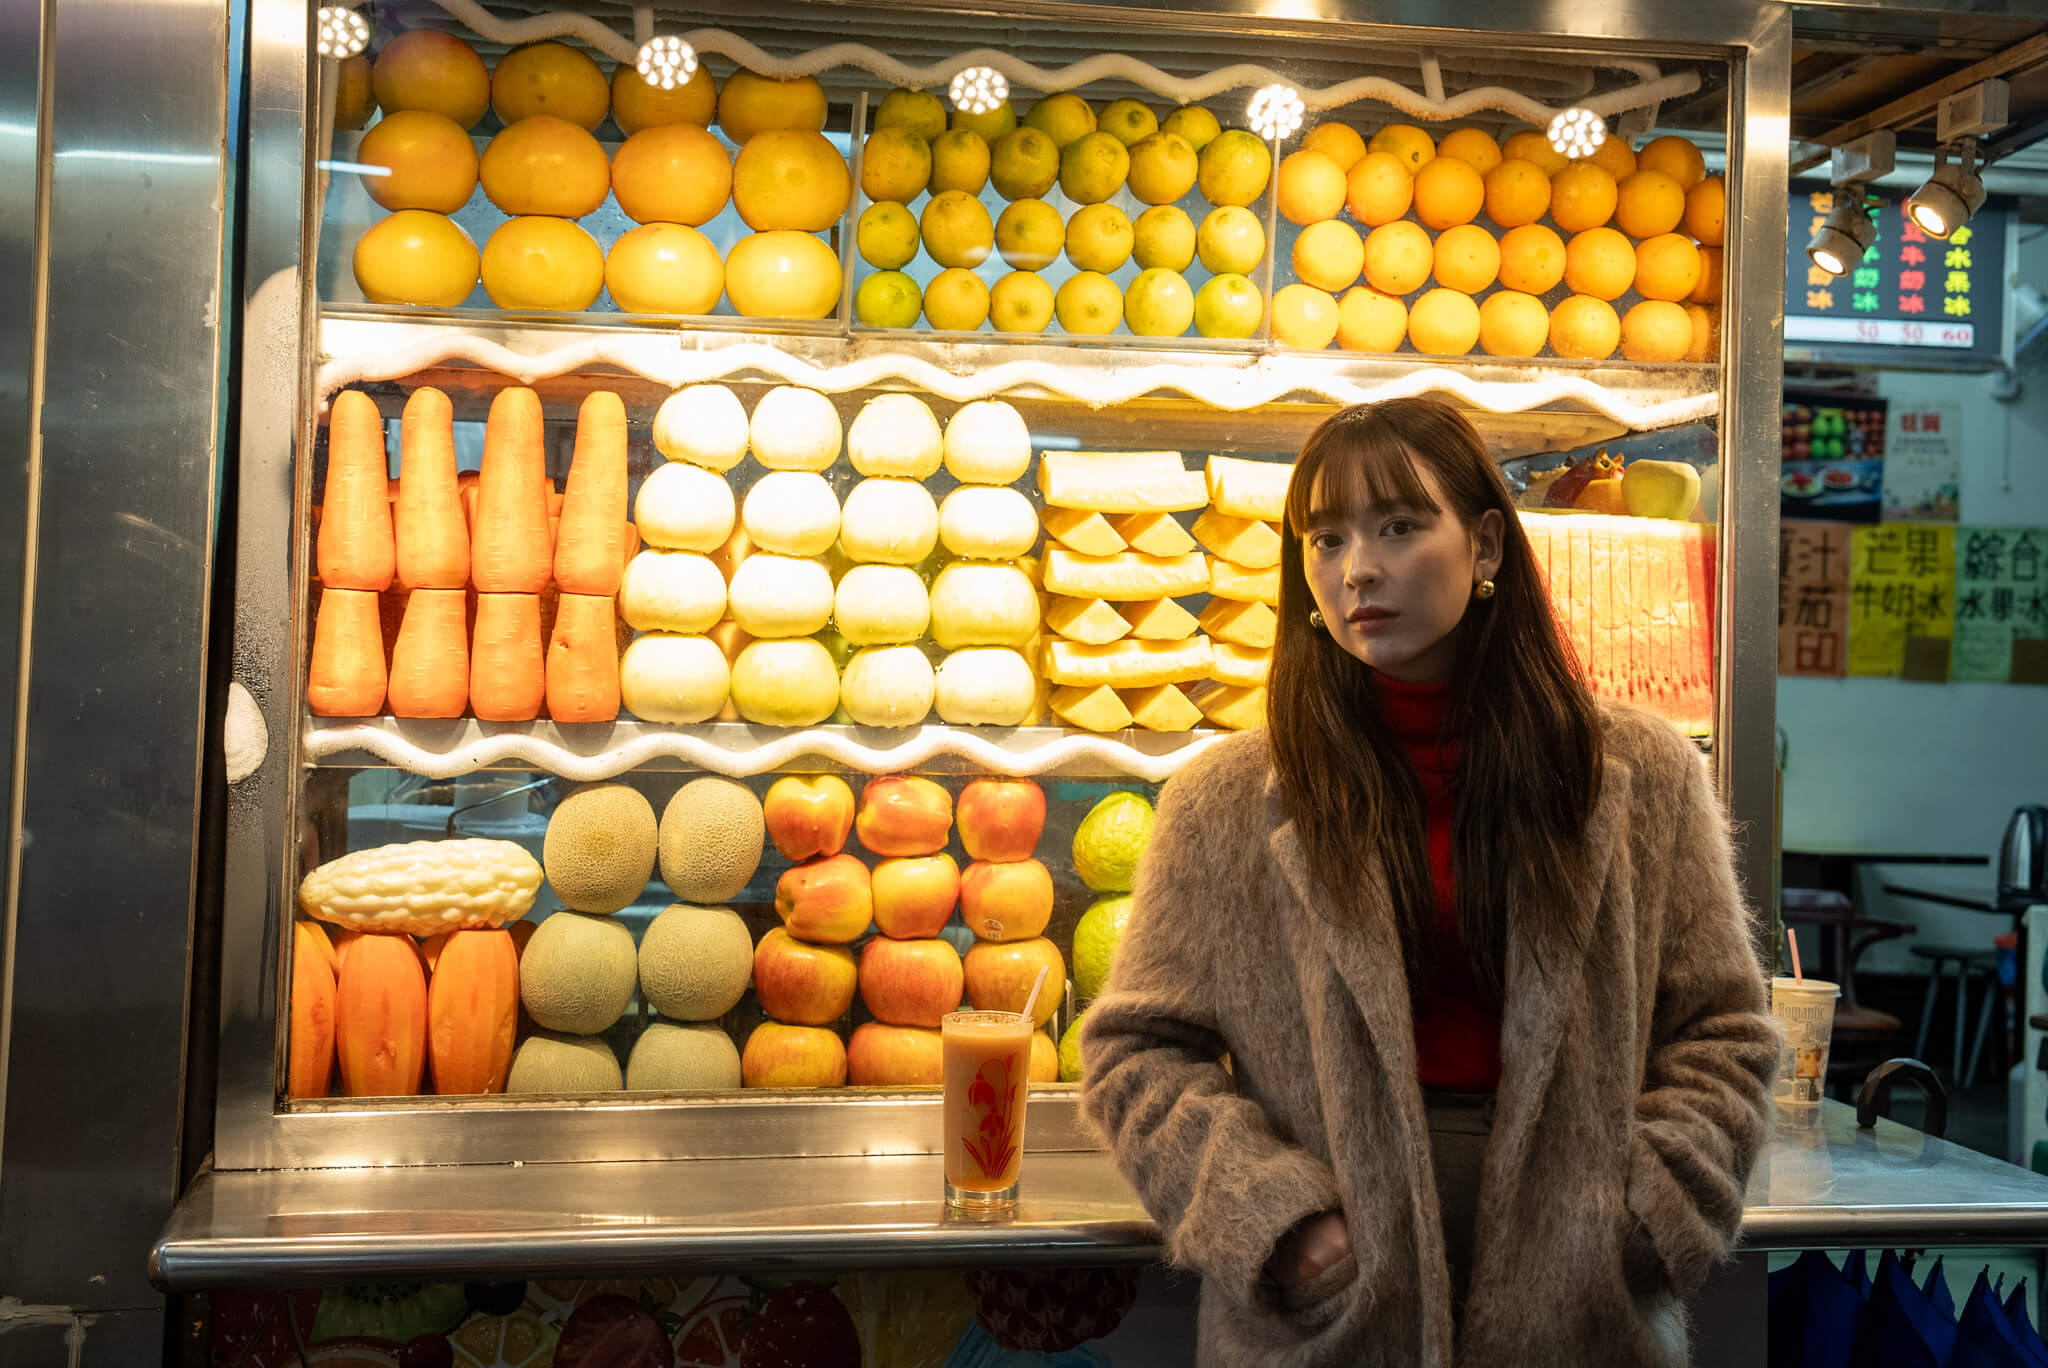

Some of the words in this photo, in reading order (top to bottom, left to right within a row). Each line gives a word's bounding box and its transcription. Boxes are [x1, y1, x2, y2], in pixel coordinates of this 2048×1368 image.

[1899, 197, 1927, 314] 豆牛奶冰
[1944, 225, 1973, 317] 合水果冰
[1857, 321, 1878, 341] 50
[1902, 323, 1924, 343] 50
[1942, 331, 1970, 343] 60
[1866, 528, 1941, 578] 芒果
[1965, 531, 2042, 582] 綜合
[1853, 580, 1946, 620] 牛奶冰
[1959, 587, 2048, 624] 水果冰
